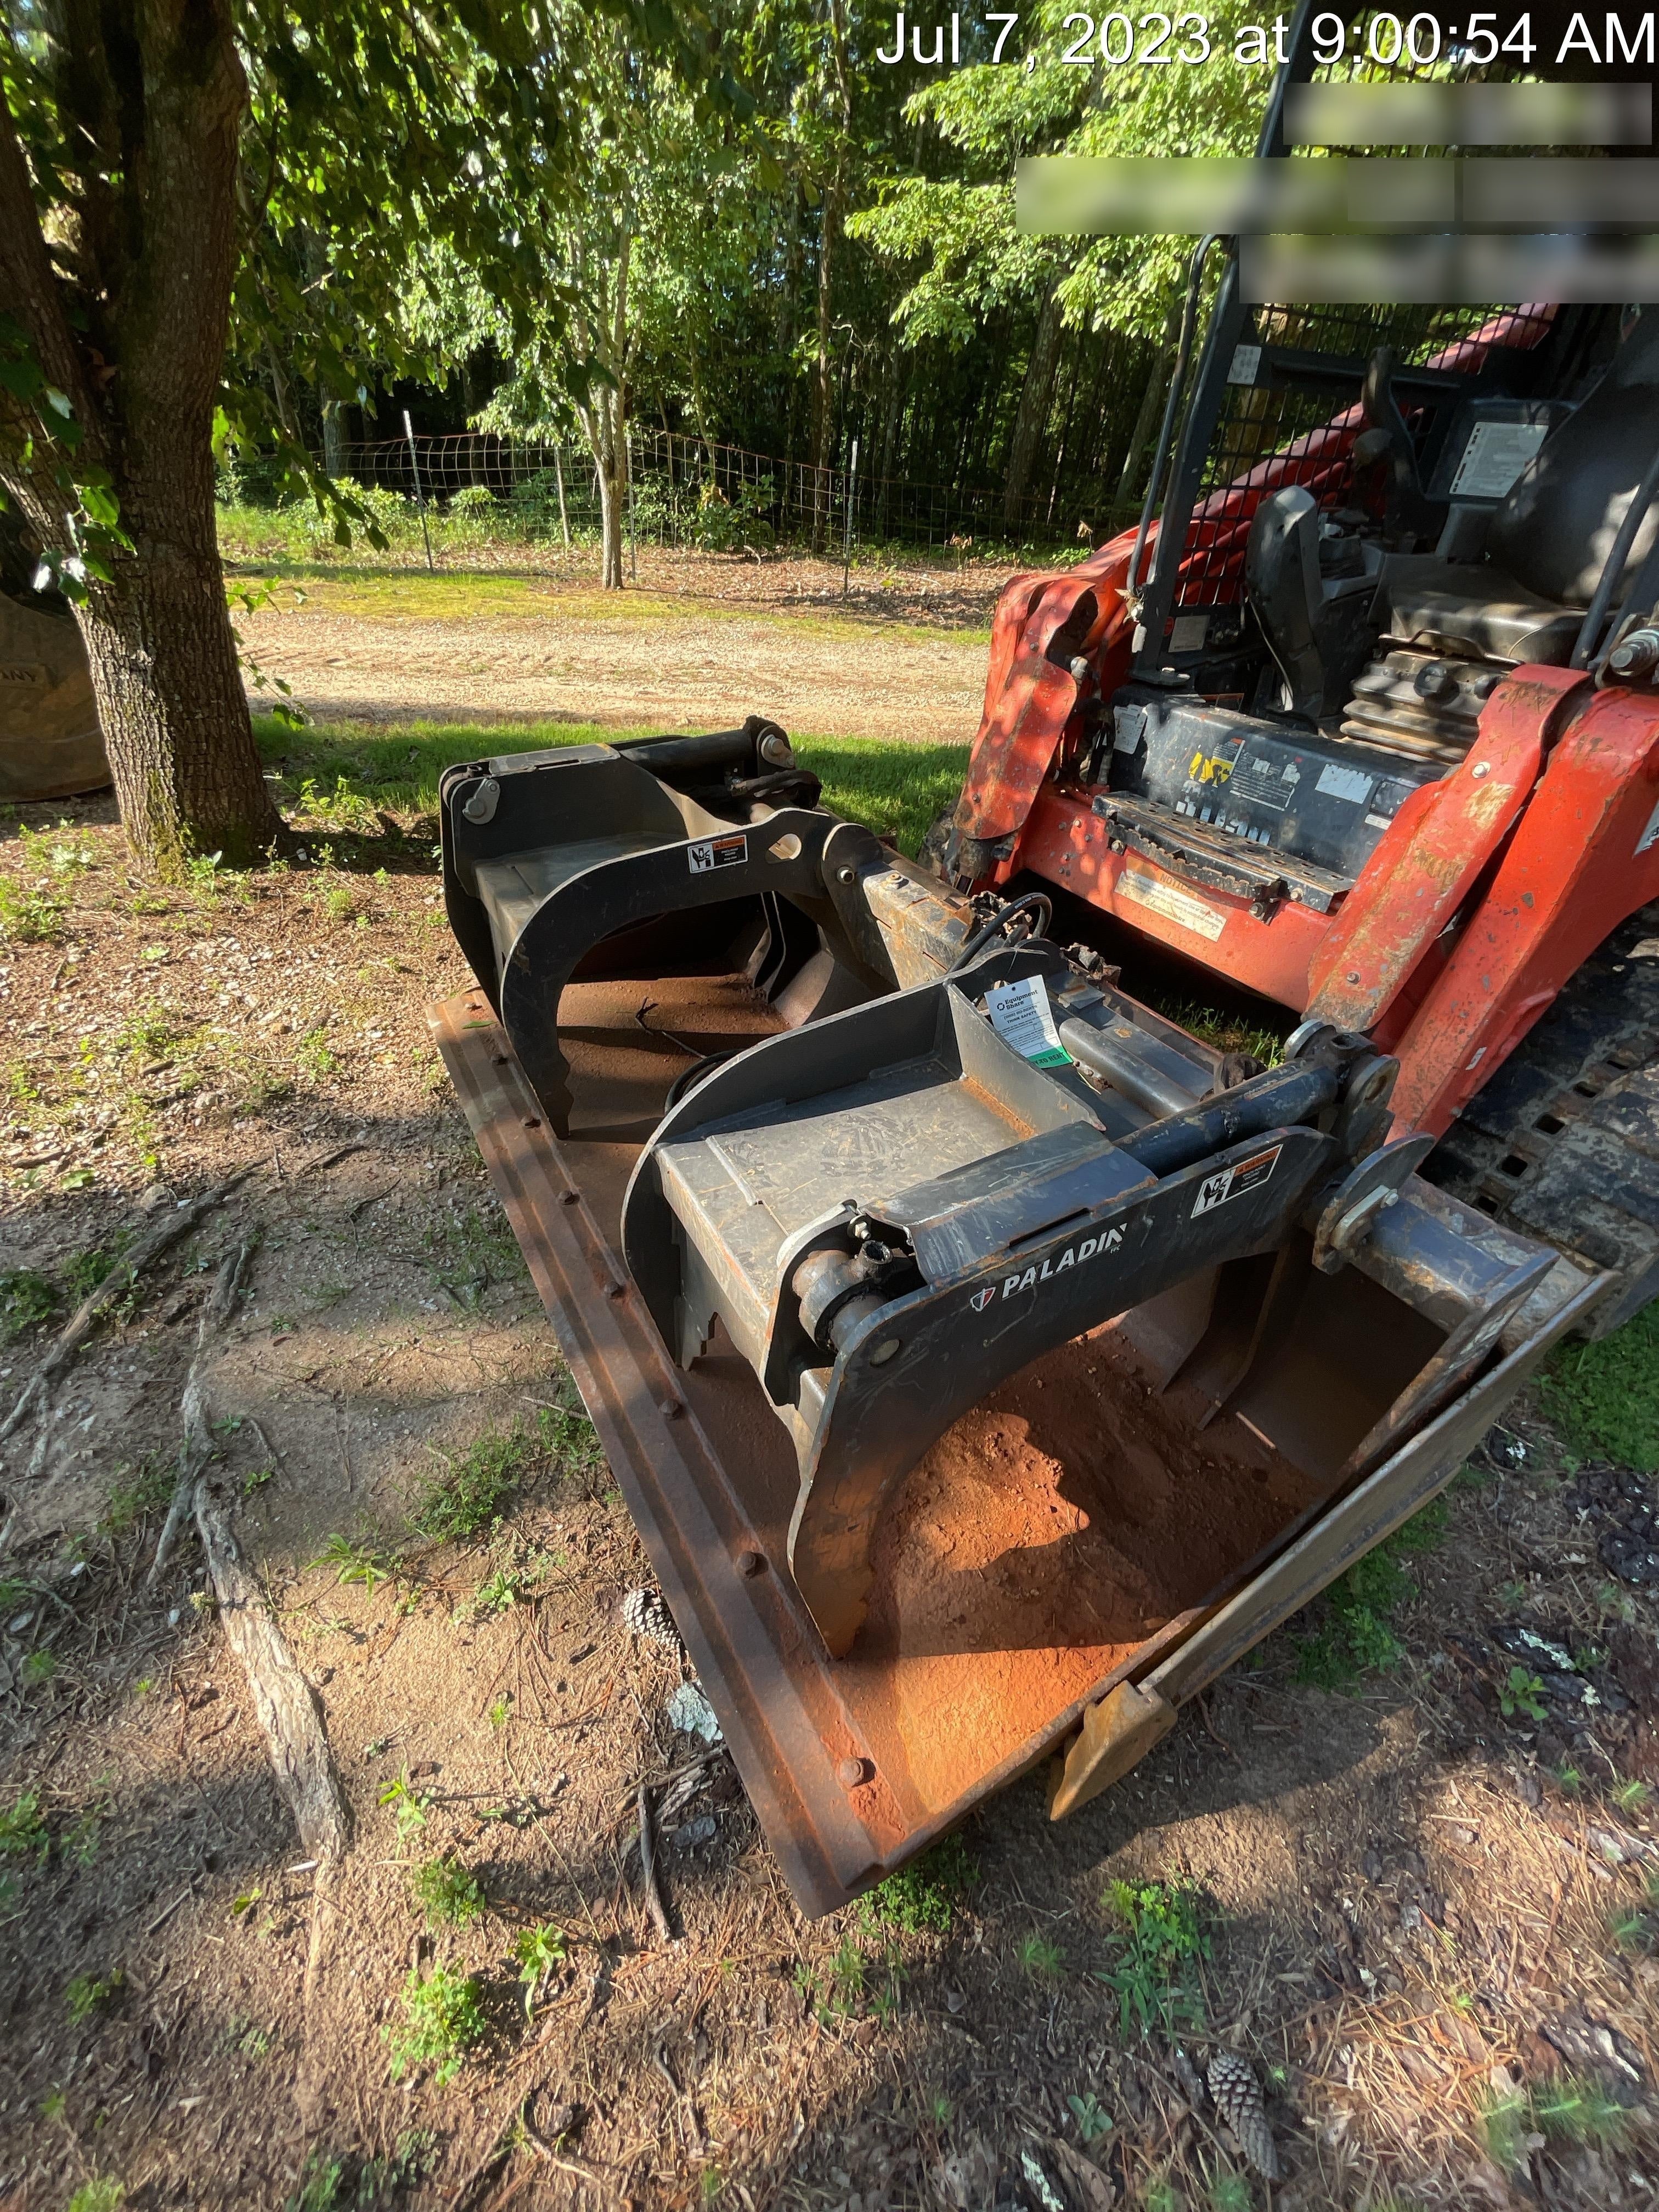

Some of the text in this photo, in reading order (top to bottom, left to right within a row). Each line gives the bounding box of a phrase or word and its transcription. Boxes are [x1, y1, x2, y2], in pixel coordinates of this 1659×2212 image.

[1005, 989, 1039, 1005] Equipment
[1006, 1000, 1024, 1010] Share
[1022, 1011, 1036, 1019] SAFETY
[1048, 1052, 1065, 1062] RENT
